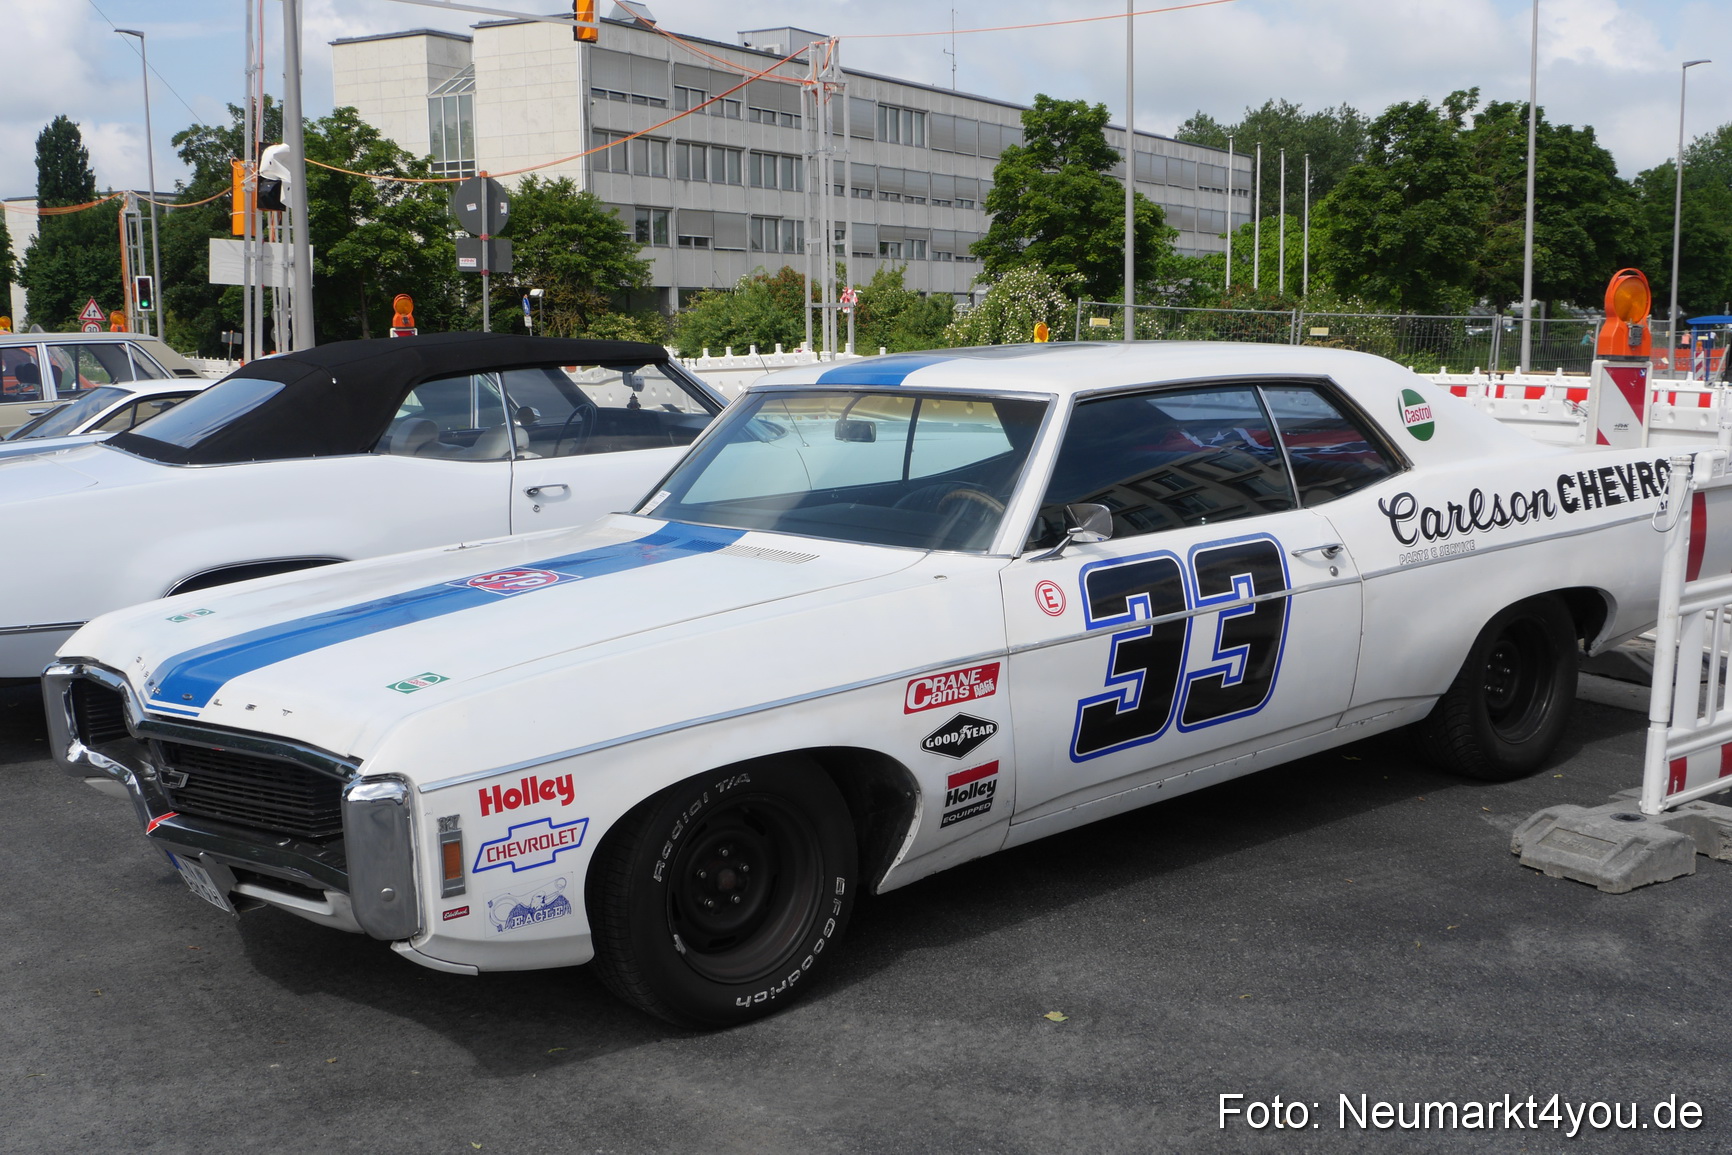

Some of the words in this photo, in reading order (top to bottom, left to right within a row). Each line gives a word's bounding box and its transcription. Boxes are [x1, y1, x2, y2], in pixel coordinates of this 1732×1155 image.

[1404, 405, 1433, 424] Castrol
[1378, 487, 1558, 548] Carlson
[1557, 453, 1698, 514] CHEVRO
[1399, 549, 1430, 566] PARTS
[1430, 547, 1437, 558] &
[1439, 539, 1476, 557] SERVICE
[1042, 588, 1059, 609] E
[1069, 532, 1293, 763] 33
[907, 669, 982, 710] CRANE
[478, 773, 576, 817] Holley
[944, 778, 997, 808] Holley
[437, 814, 460, 832] 327
[653, 792, 708, 882] Radial
[715, 772, 751, 793] T/A
[942, 802, 992, 824] EQUIPPED
[487, 827, 578, 863] CHEVROLET
[511, 905, 564, 929] EAGLE
[736, 877, 846, 1007] BFGoodrich
